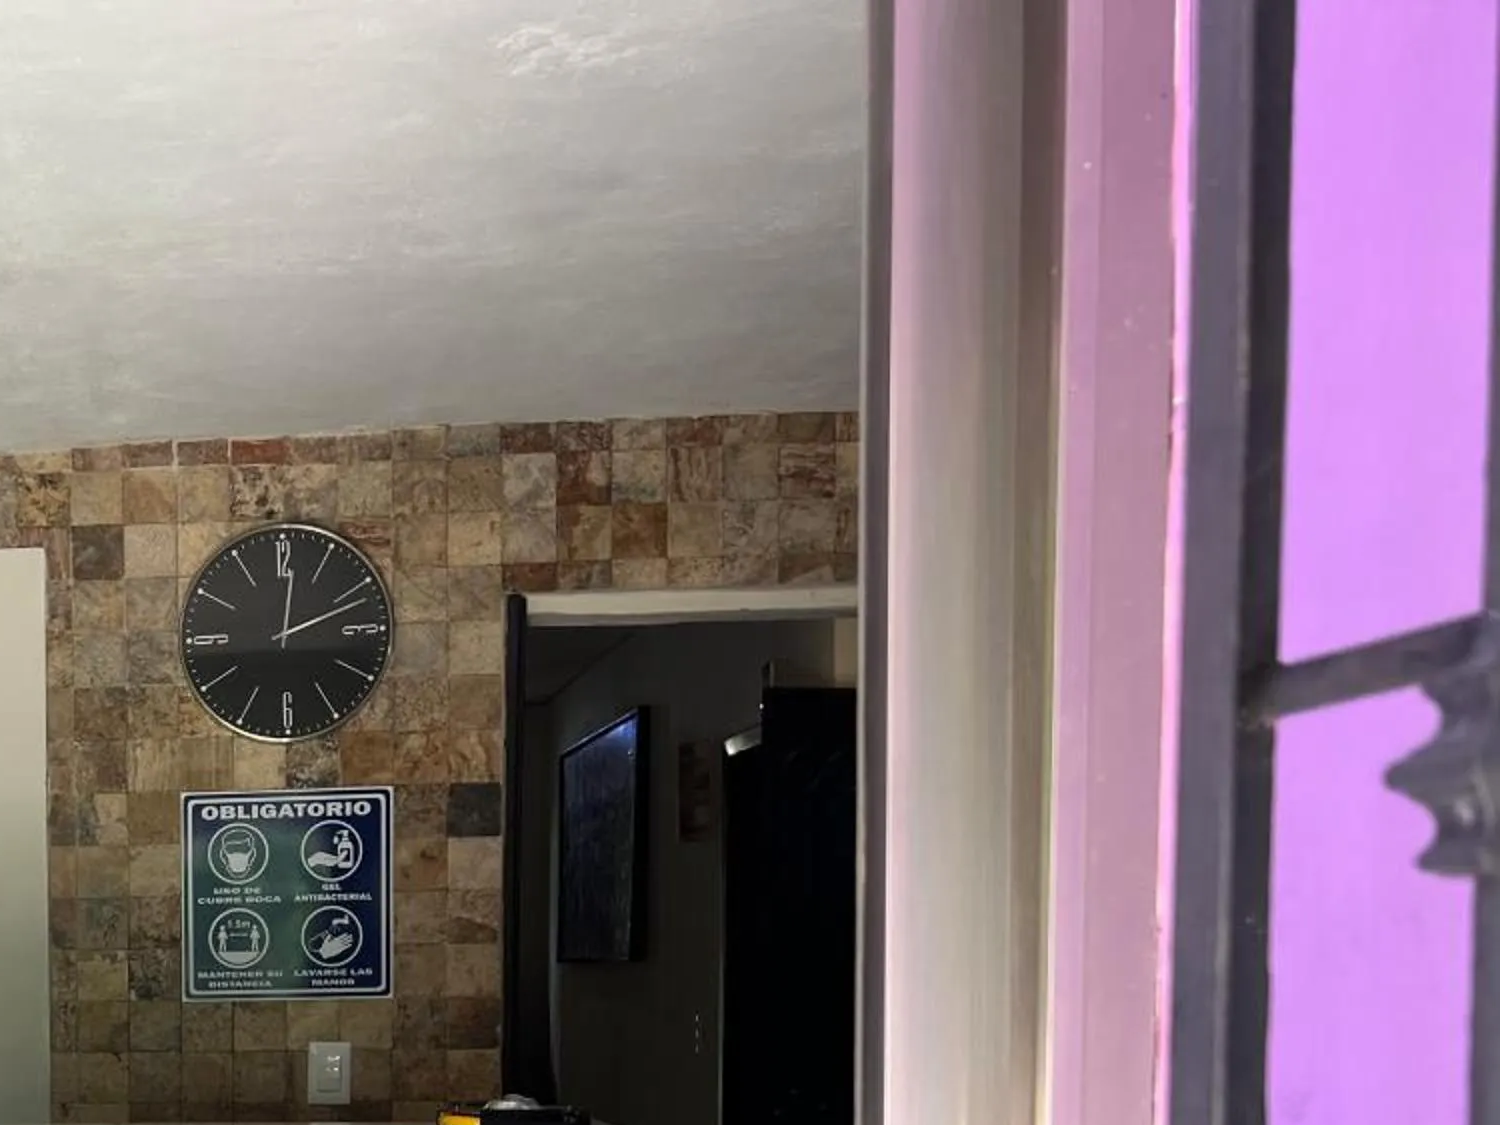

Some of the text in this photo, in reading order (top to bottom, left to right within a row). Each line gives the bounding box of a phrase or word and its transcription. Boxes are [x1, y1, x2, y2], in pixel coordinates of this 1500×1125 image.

[201, 801, 371, 820] OBLIGATORIO
[245, 895, 282, 904] BOCA
[294, 892, 373, 901] ANTIBACTERIAL
[197, 970, 263, 979] MANTENER
[293, 967, 373, 976] LAVARSE LAS
[311, 978, 355, 986] MANOS
